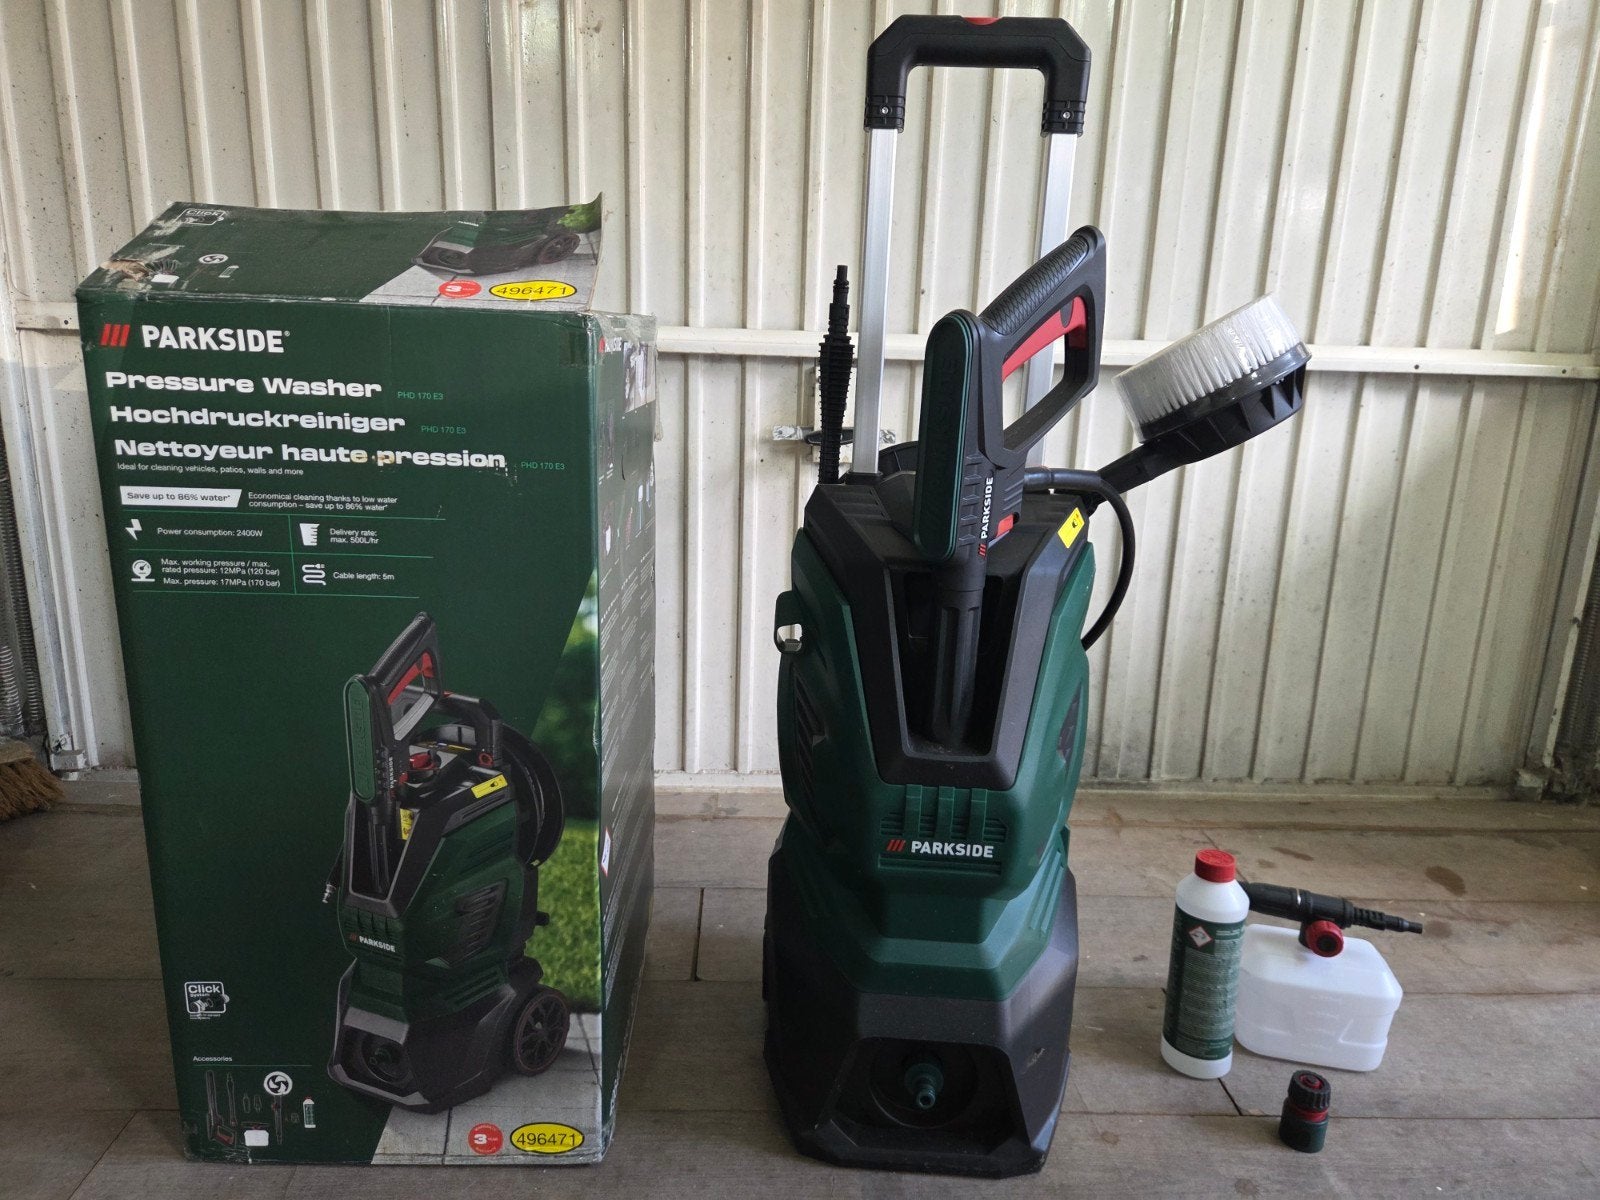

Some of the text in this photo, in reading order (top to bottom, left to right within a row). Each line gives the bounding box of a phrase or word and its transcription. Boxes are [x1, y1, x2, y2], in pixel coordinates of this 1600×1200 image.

[445, 285, 462, 293] 3
[497, 286, 567, 295] 496471
[105, 371, 382, 398] Pressure Washer
[397, 391, 444, 401] PHD 170 E3
[110, 406, 406, 433] Hochdruckreiniger
[421, 425, 466, 435] PHD 170 E3
[114, 439, 506, 468] Nettoyeur haute pression
[117, 462, 136, 470] Ideal
[151, 464, 183, 473] cleaning
[185, 464, 218, 473] vehicles,
[220, 466, 245, 475] patios,
[268, 467, 283, 475] and
[520, 461, 565, 470] PHD 170 E3
[127, 492, 150, 500] Save
[248, 492, 291, 501] Economical
[293, 494, 325, 503] cleaning
[326, 494, 351, 503] thanks
[377, 496, 398, 504] water
[248, 500, 297, 509] consumption
[336, 502, 344, 510] to
[345, 502, 363, 510] 86%
[981, 476, 994, 540] PARKSIDE
[184, 528, 235, 538] consumption:
[330, 528, 377, 537] Delivery rate:
[350, 536, 379, 545] 500L/hr
[160, 558, 179, 566] Max.
[182, 559, 212, 568] working
[213, 560, 246, 568] pressure
[162, 566, 181, 574] rated
[247, 568, 264, 576] (120
[265, 568, 280, 576] bar)
[333, 572, 395, 581] Cable length: 5m
[184, 578, 219, 587] pressure:
[220, 578, 247, 586] 17MPa
[248, 579, 264, 587] (170
[266, 580, 281, 588] bar)
[911, 840, 995, 858] PARKSIDE
[359, 935, 396, 953] PARKSIDE
[188, 984, 220, 993] Click
[474, 1133, 487, 1145] 3
[516, 1132, 576, 1147] 496471
